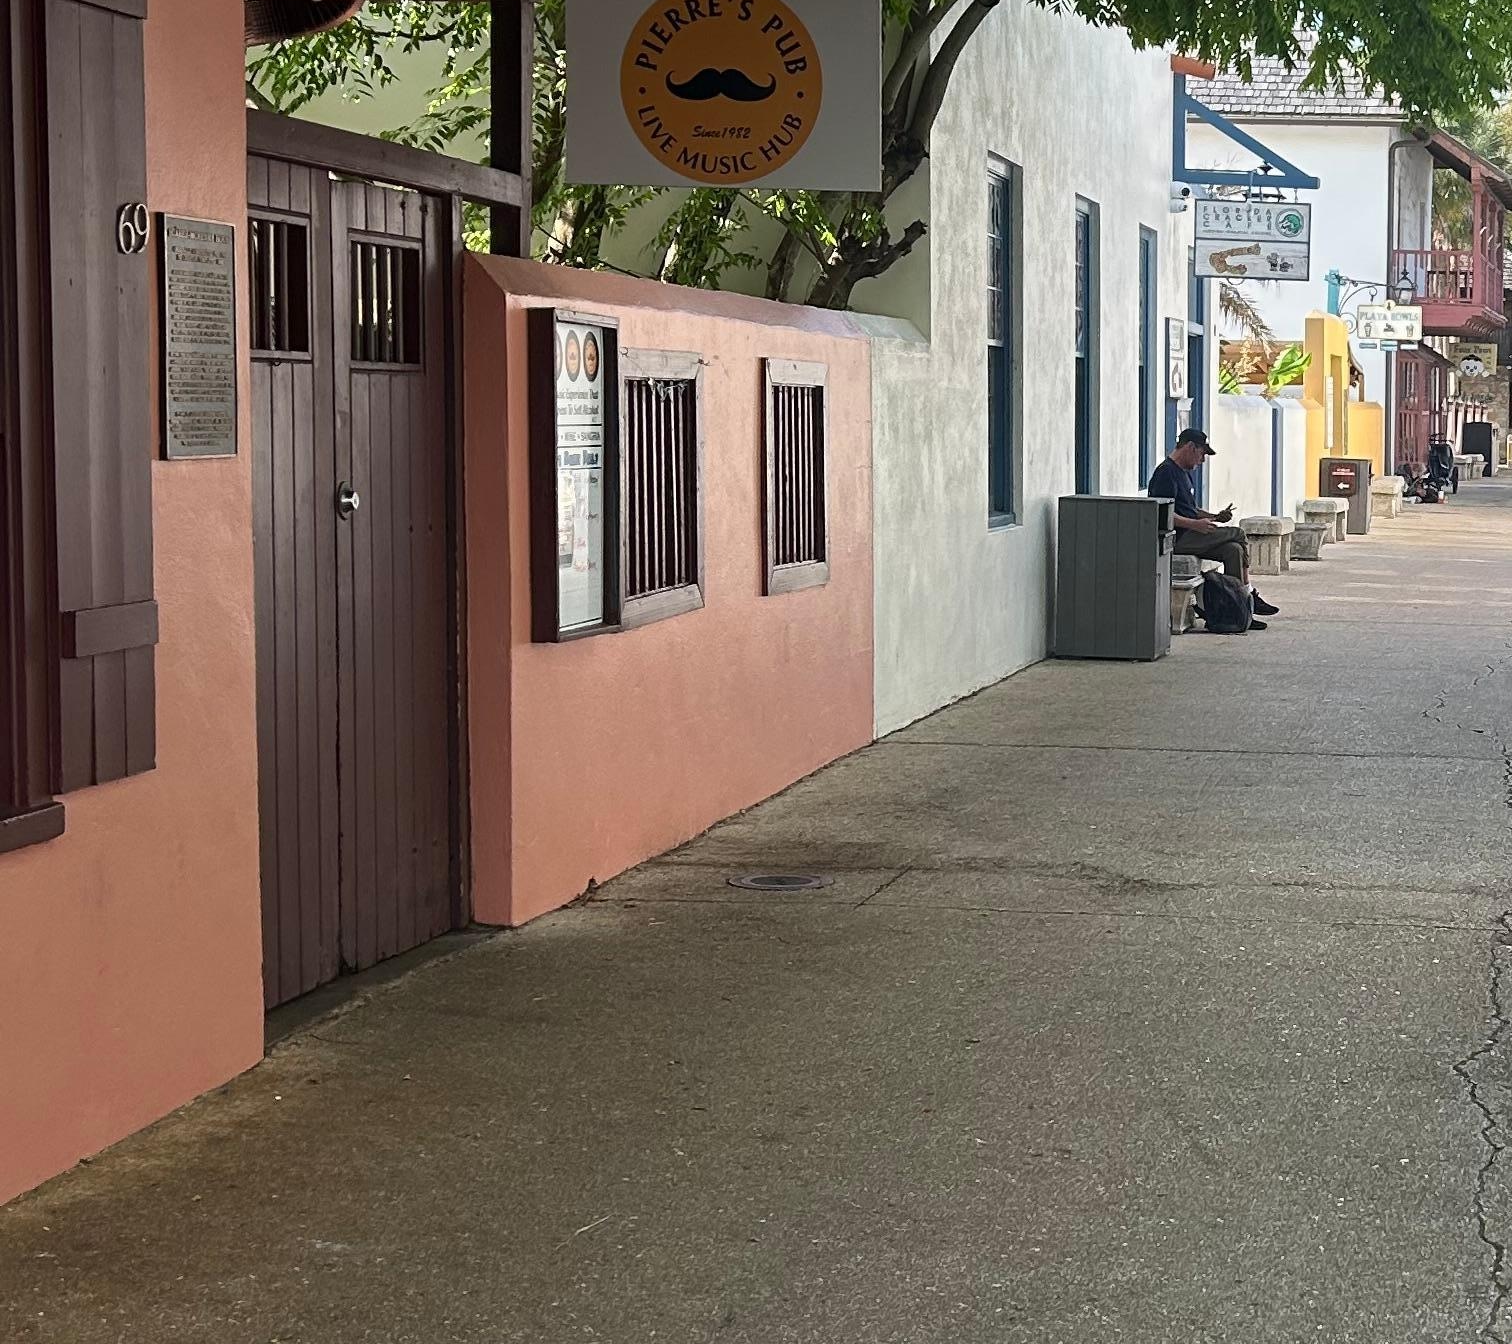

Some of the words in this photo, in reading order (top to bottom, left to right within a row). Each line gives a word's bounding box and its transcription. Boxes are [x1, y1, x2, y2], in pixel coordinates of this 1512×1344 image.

[761, 13, 807, 74] PUB
[638, 106, 678, 154] LIVE
[677, 147, 756, 174] MUSIC
[759, 113, 802, 162] HUB
[119, 203, 151, 255] 69
[1360, 311, 1387, 321] PLAYA
[1391, 312, 1418, 321] BOWLS
